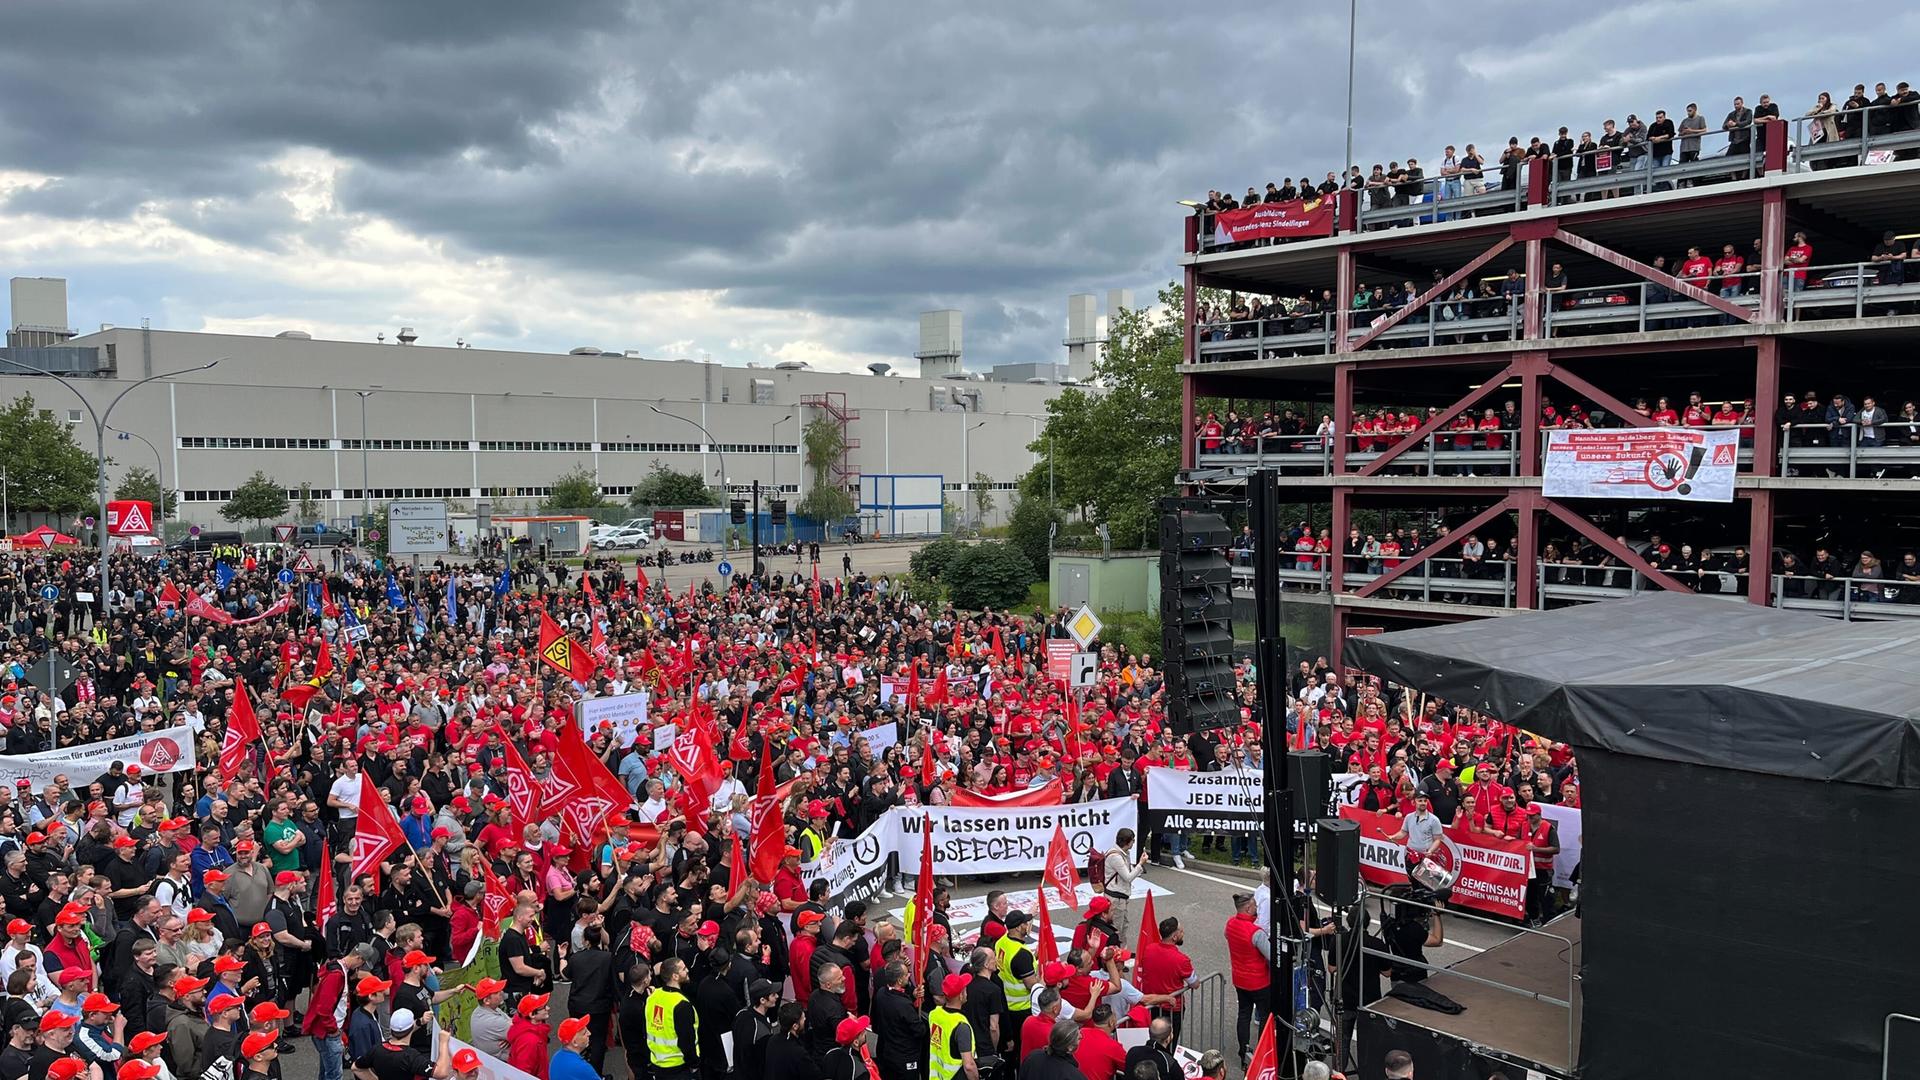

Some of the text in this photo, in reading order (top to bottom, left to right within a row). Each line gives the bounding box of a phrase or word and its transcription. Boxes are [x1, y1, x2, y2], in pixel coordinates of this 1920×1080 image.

[1254, 209, 1286, 219] Ausbildung
[1272, 219, 1310, 228] Sindelfingen
[1617, 434, 1656, 442] Heidelberg
[1615, 452, 1653, 460] Zukunft
[71, 751, 84, 760] für
[84, 746, 112, 758] unsere
[113, 738, 148, 752] Zukunft!
[1188, 775, 1264, 787] Zusamme
[1186, 793, 1264, 807] JEDE Nied
[901, 808, 1110, 834] Wir lassen uns nicht
[1164, 815, 1193, 829] Alle
[1360, 842, 1405, 869] TARK.
[1463, 848, 1523, 871] NUR MIT DIR.
[1452, 886, 1486, 900] ERREICHEN
[1485, 894, 1500, 903] WIR
[1461, 876, 1519, 899] GEMEINSAM
